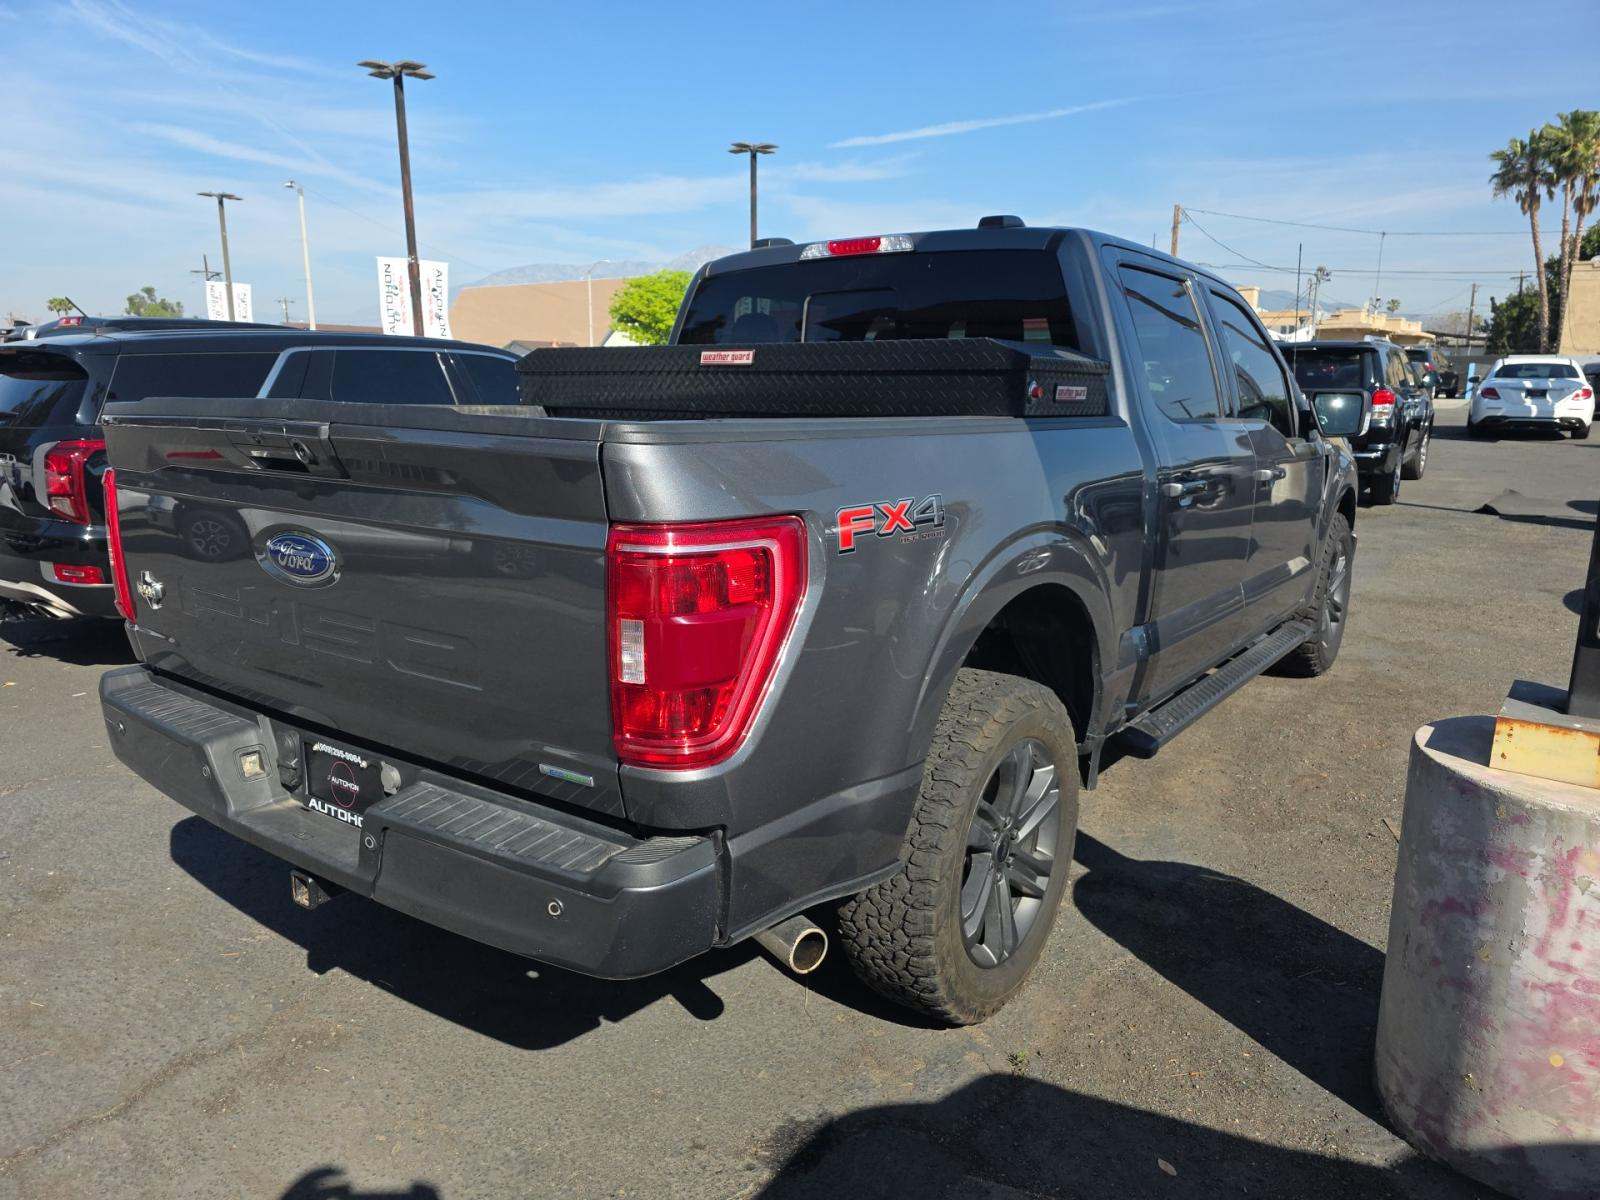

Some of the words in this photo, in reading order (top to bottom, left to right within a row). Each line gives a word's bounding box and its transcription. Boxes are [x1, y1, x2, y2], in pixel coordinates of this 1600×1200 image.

[702, 353, 730, 361] weather
[731, 352, 751, 363] guard
[835, 493, 945, 556] FX4
[278, 541, 315, 571] Ford
[331, 776, 360, 793] AUTOHON
[308, 798, 364, 828] AUTOH
